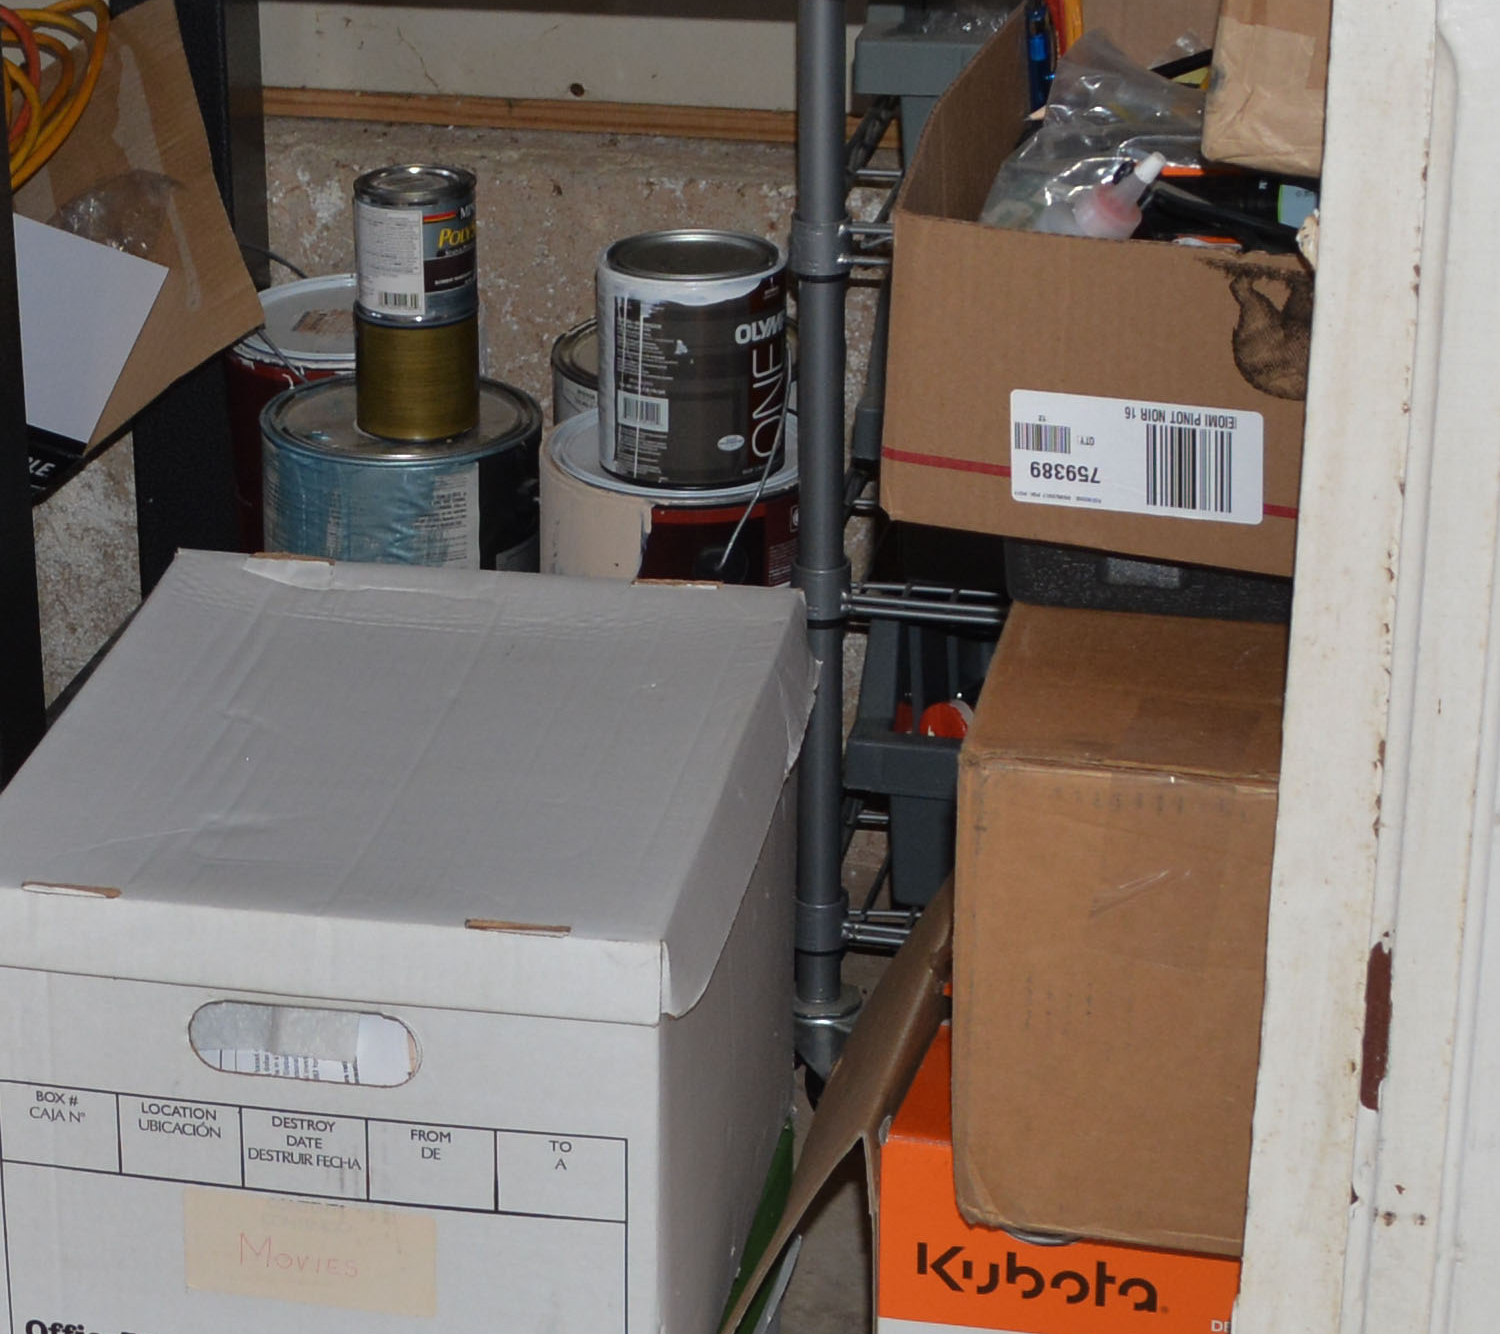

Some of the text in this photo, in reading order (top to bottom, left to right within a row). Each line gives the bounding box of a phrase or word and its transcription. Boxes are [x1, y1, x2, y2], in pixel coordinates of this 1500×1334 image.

[752, 344, 784, 458] ONE
[1124, 406, 1237, 430] EIOMI PINOT NOIR 16
[1030, 461, 1102, 484] 759389
[35, 1089, 79, 1107] BOX #
[29, 1106, 66, 1122] CAJA
[141, 1102, 218, 1121] LOCATION
[138, 1118, 222, 1139] UBICACIÓN
[271, 1115, 336, 1133] DESTROY
[286, 1134, 323, 1149] DATE
[410, 1129, 451, 1143] FROM
[421, 1146, 441, 1160] DE
[549, 1140, 572, 1153] TO
[247, 1147, 362, 1171] DESTRUIR FECHA
[555, 1158, 567, 1170] A
[916, 1242, 1158, 1313] Kubota
